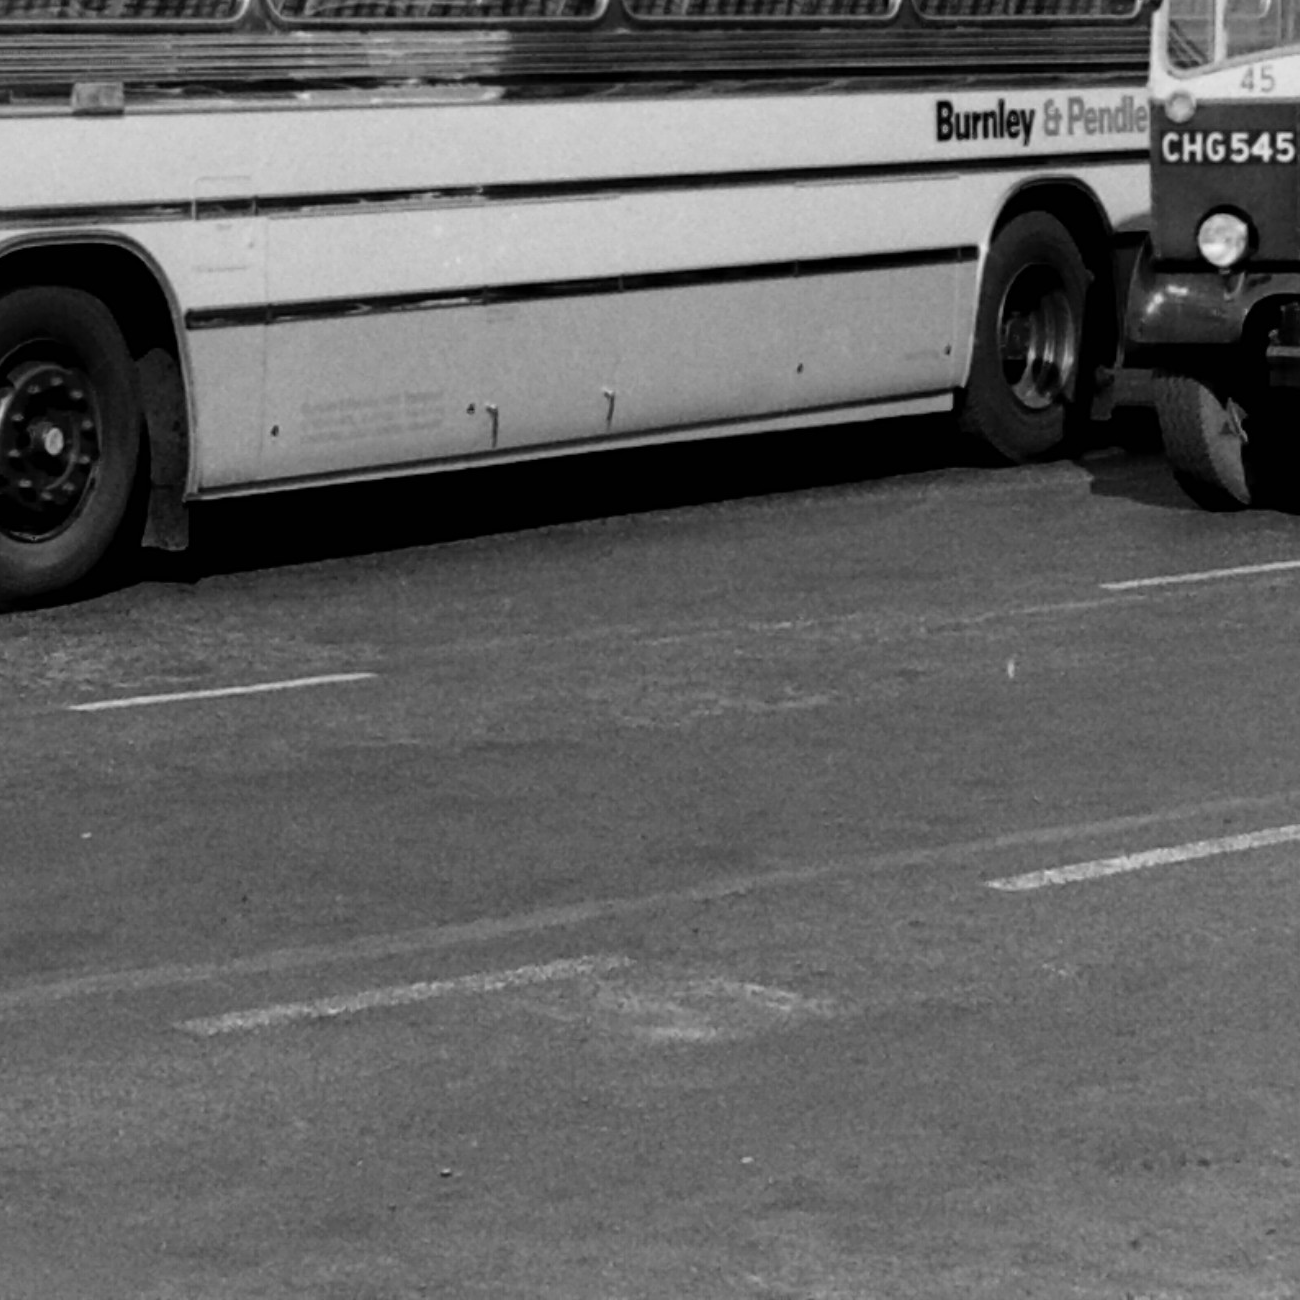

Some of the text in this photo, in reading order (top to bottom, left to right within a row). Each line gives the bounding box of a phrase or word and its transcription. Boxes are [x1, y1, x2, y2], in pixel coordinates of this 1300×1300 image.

[1240, 64, 1276, 93] 45
[936, 94, 1149, 147] Burnley & Pendle
[1161, 131, 1296, 163] CHG545
